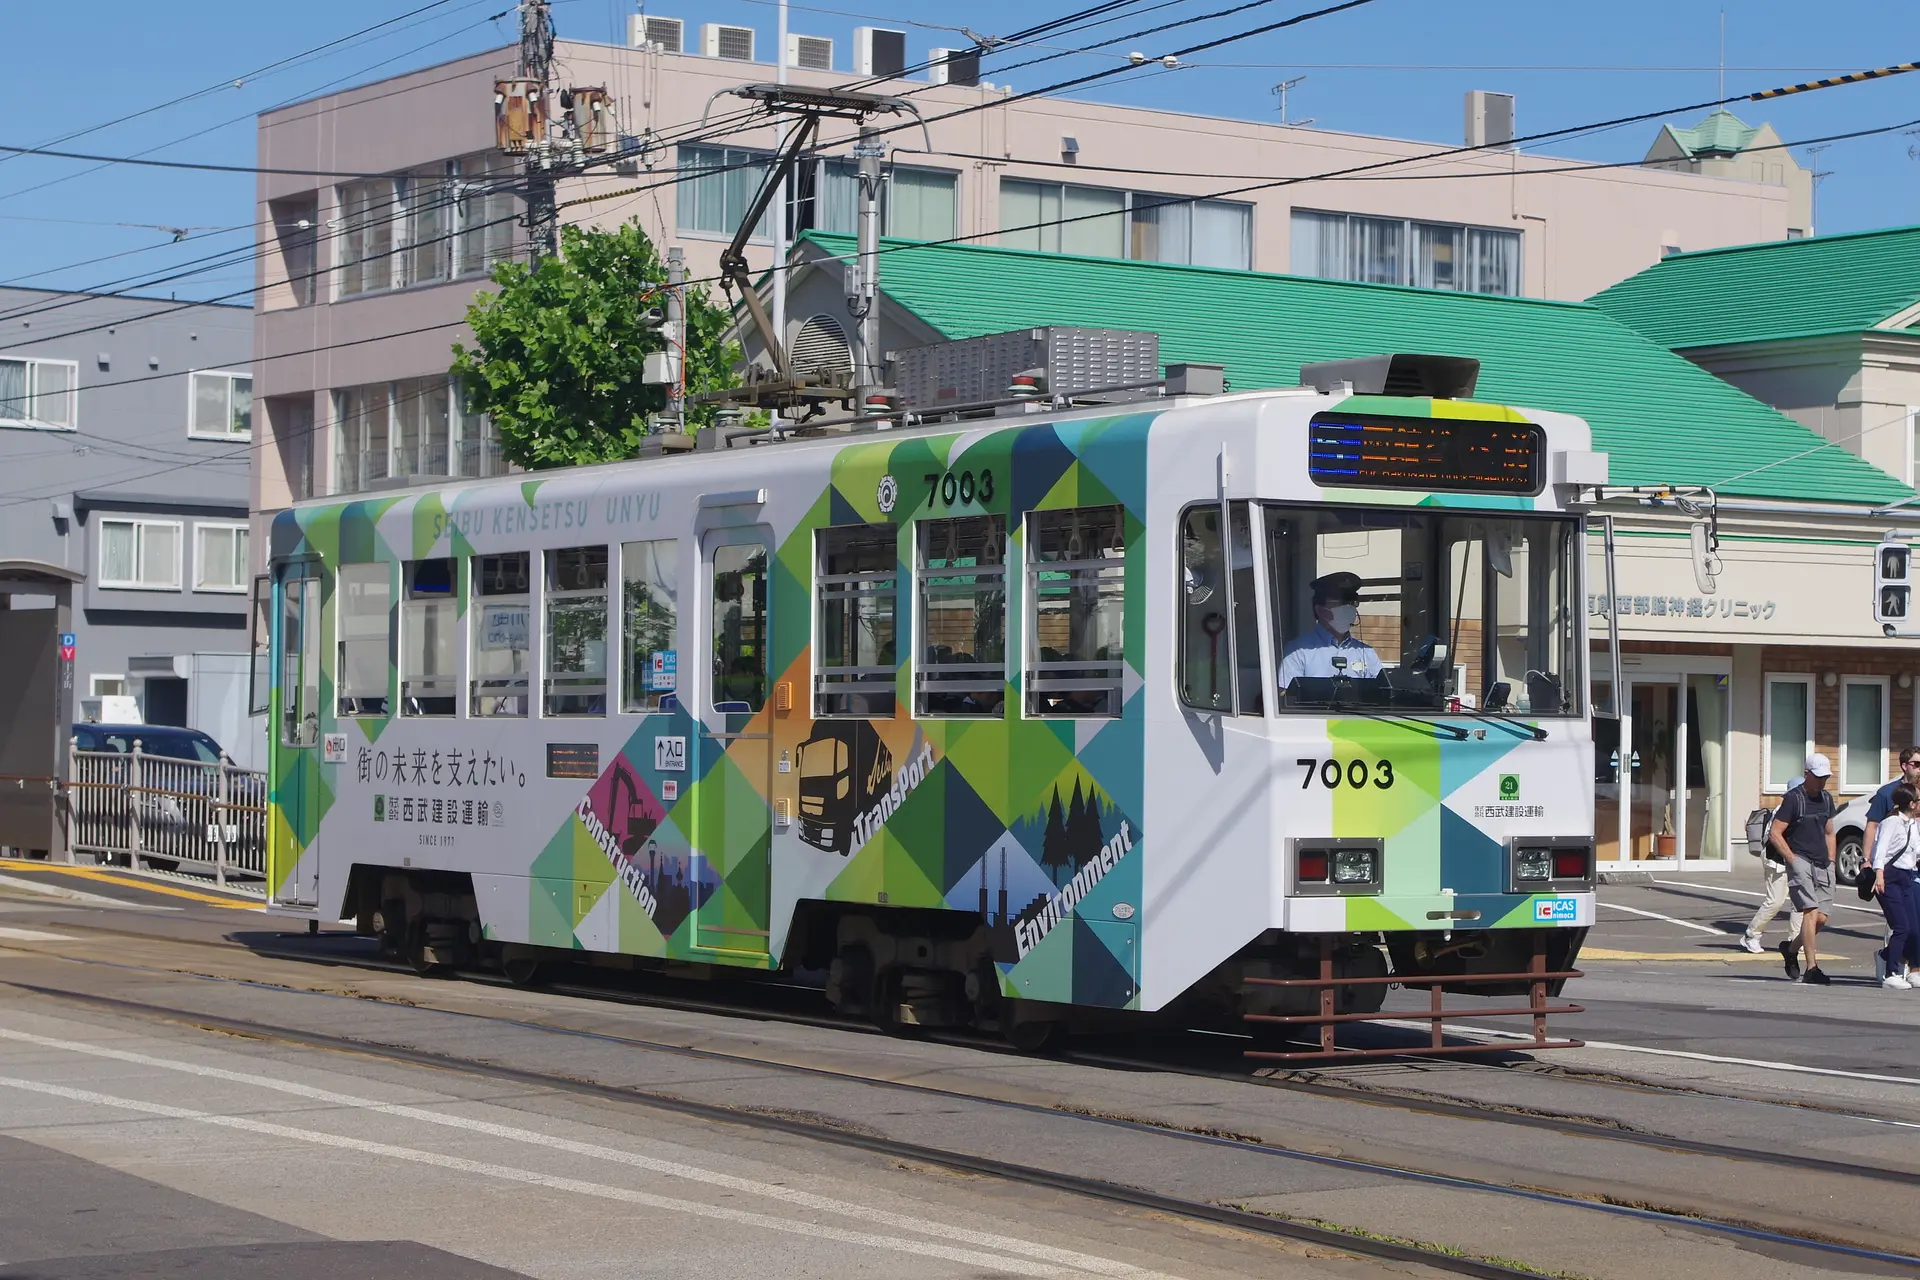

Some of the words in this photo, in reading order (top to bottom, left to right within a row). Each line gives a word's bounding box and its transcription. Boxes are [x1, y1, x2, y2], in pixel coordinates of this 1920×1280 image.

[924, 469, 994, 508] 7003
[433, 511, 484, 539] SEIBU
[493, 500, 588, 534] KENSETSU
[606, 493, 661, 525] UNYU
[64, 635, 74, 646] D
[64, 648, 73, 659] Y
[333, 736, 345, 752] 出口
[666, 740, 682, 758] 入口
[357, 746, 526, 788] 街の未来を支えたい。
[665, 760, 684, 768] ENTRANCE
[1296, 759, 1395, 790] 7003
[1505, 781, 1513, 790] 21
[403, 797, 489, 827] 西武建設運輸
[1485, 805, 1544, 818] 西武建設運輸
[419, 834, 437, 847] SINCE
[440, 836, 455, 848] 1977
[578, 794, 658, 921] Construction
[1014, 819, 1133, 961] Environment
[1553, 900, 1574, 911] ICAS
